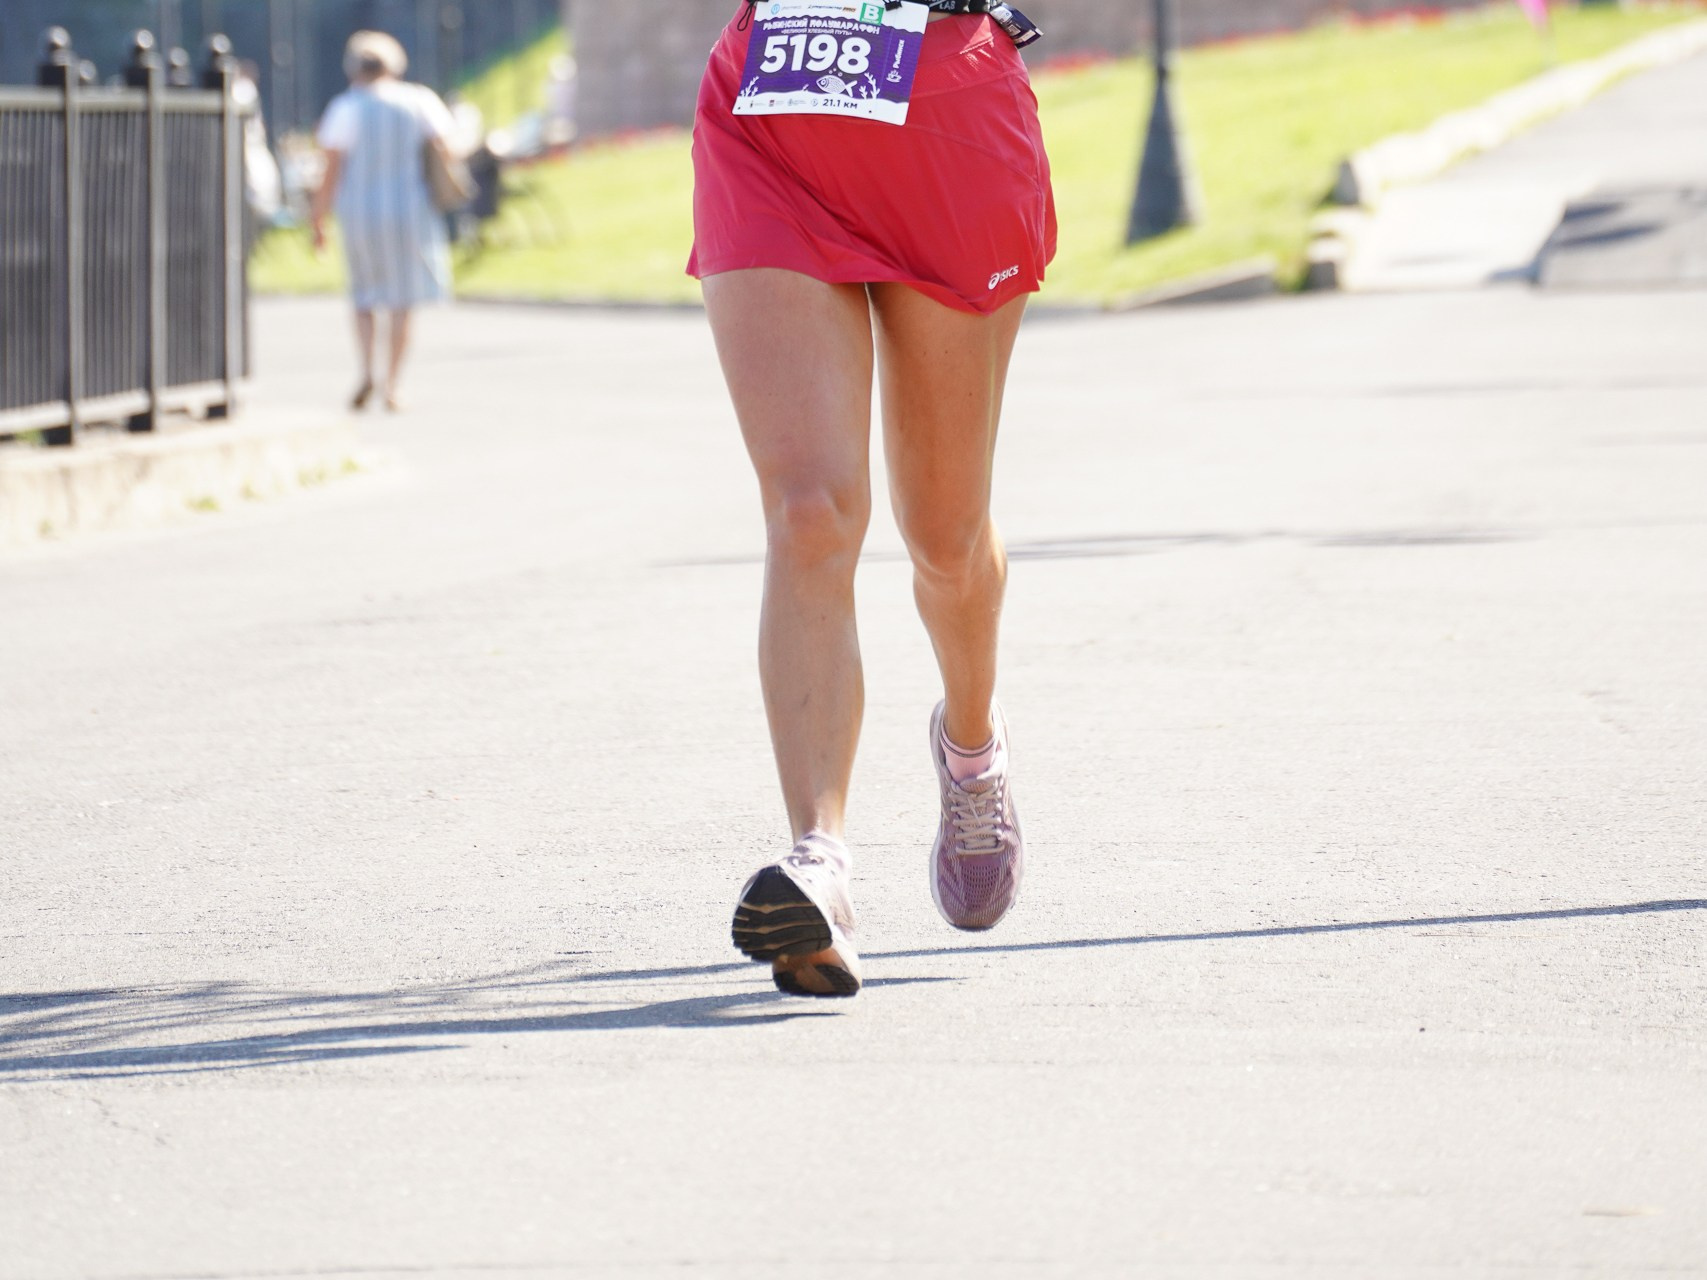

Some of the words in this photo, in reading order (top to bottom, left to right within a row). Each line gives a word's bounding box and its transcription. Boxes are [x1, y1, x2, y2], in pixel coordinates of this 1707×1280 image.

[939, 0, 956, 10] LAB
[809, 20, 880, 35] ПОЛУМАРАФОН
[759, 33, 872, 75] 5198
[822, 98, 841, 108] 21.1
